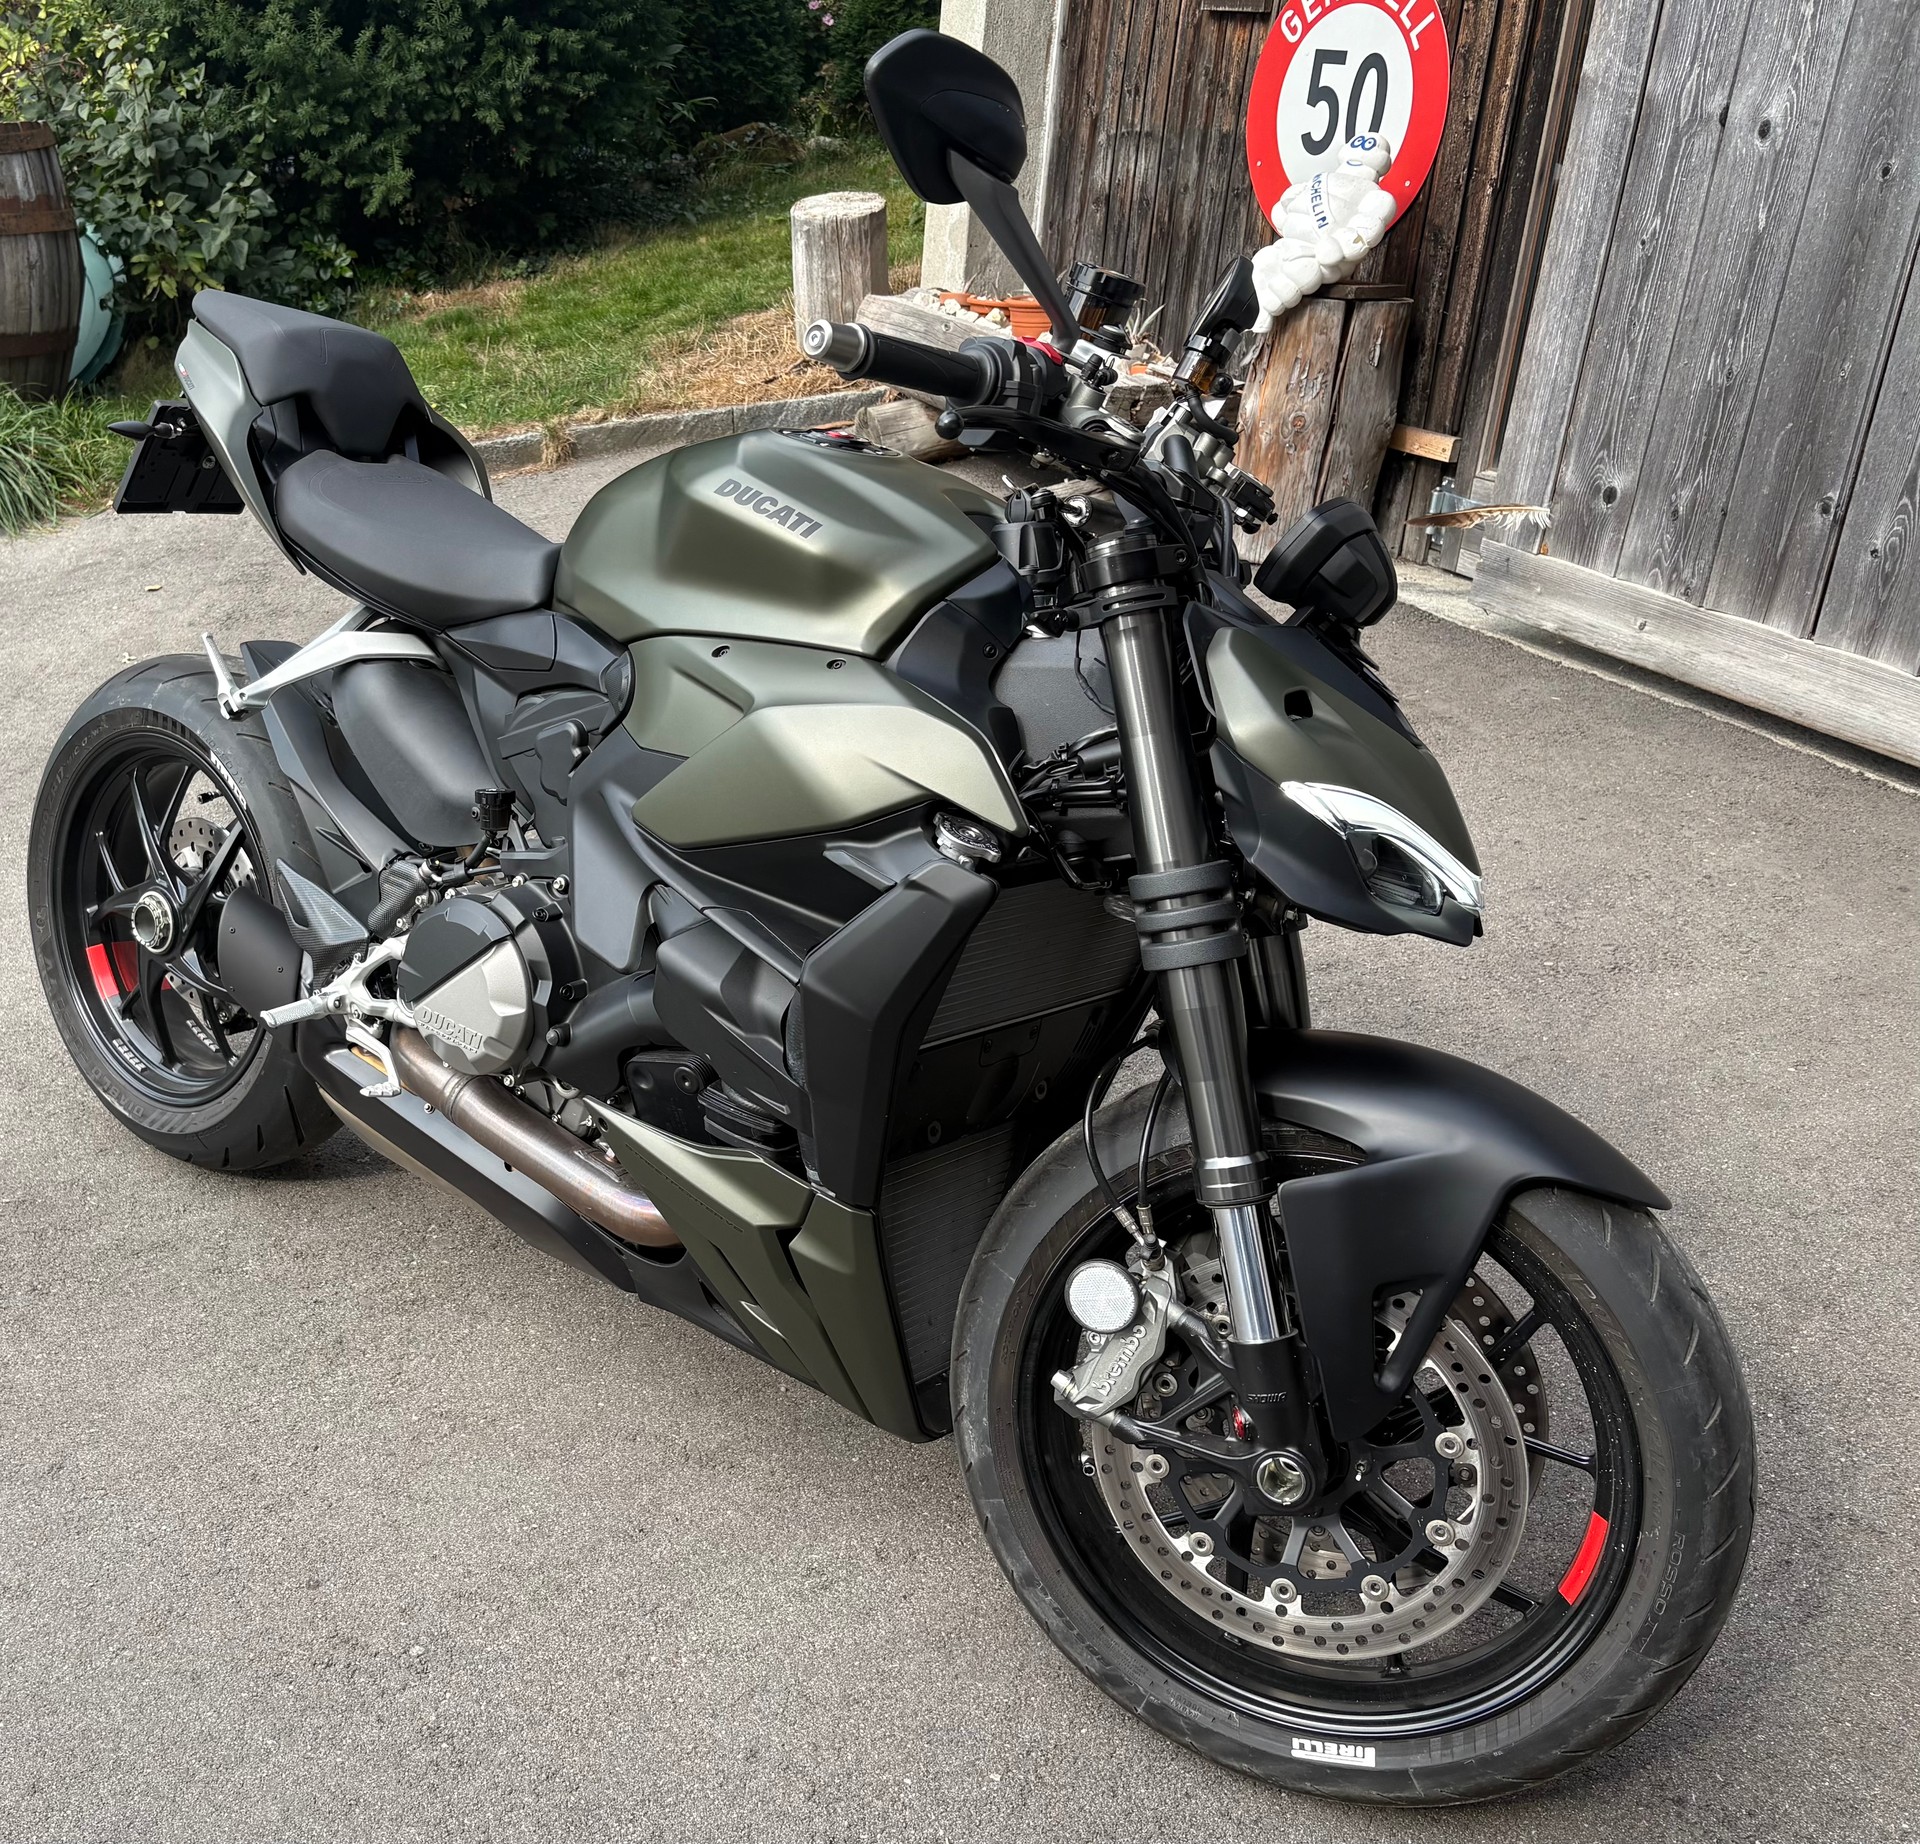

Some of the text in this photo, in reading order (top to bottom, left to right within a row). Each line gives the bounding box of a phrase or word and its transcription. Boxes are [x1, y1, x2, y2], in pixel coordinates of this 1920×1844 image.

[1281, 0, 1435, 51] GELL
[1300, 48, 1389, 156] 50
[713, 478, 824, 540] DUCATI
[419, 1004, 484, 1051] DUCATI
[1091, 1324, 1148, 1397] brembo
[1651, 1530, 1686, 1616] ROSSO
[1290, 1737, 1376, 1768] PIRELLI
